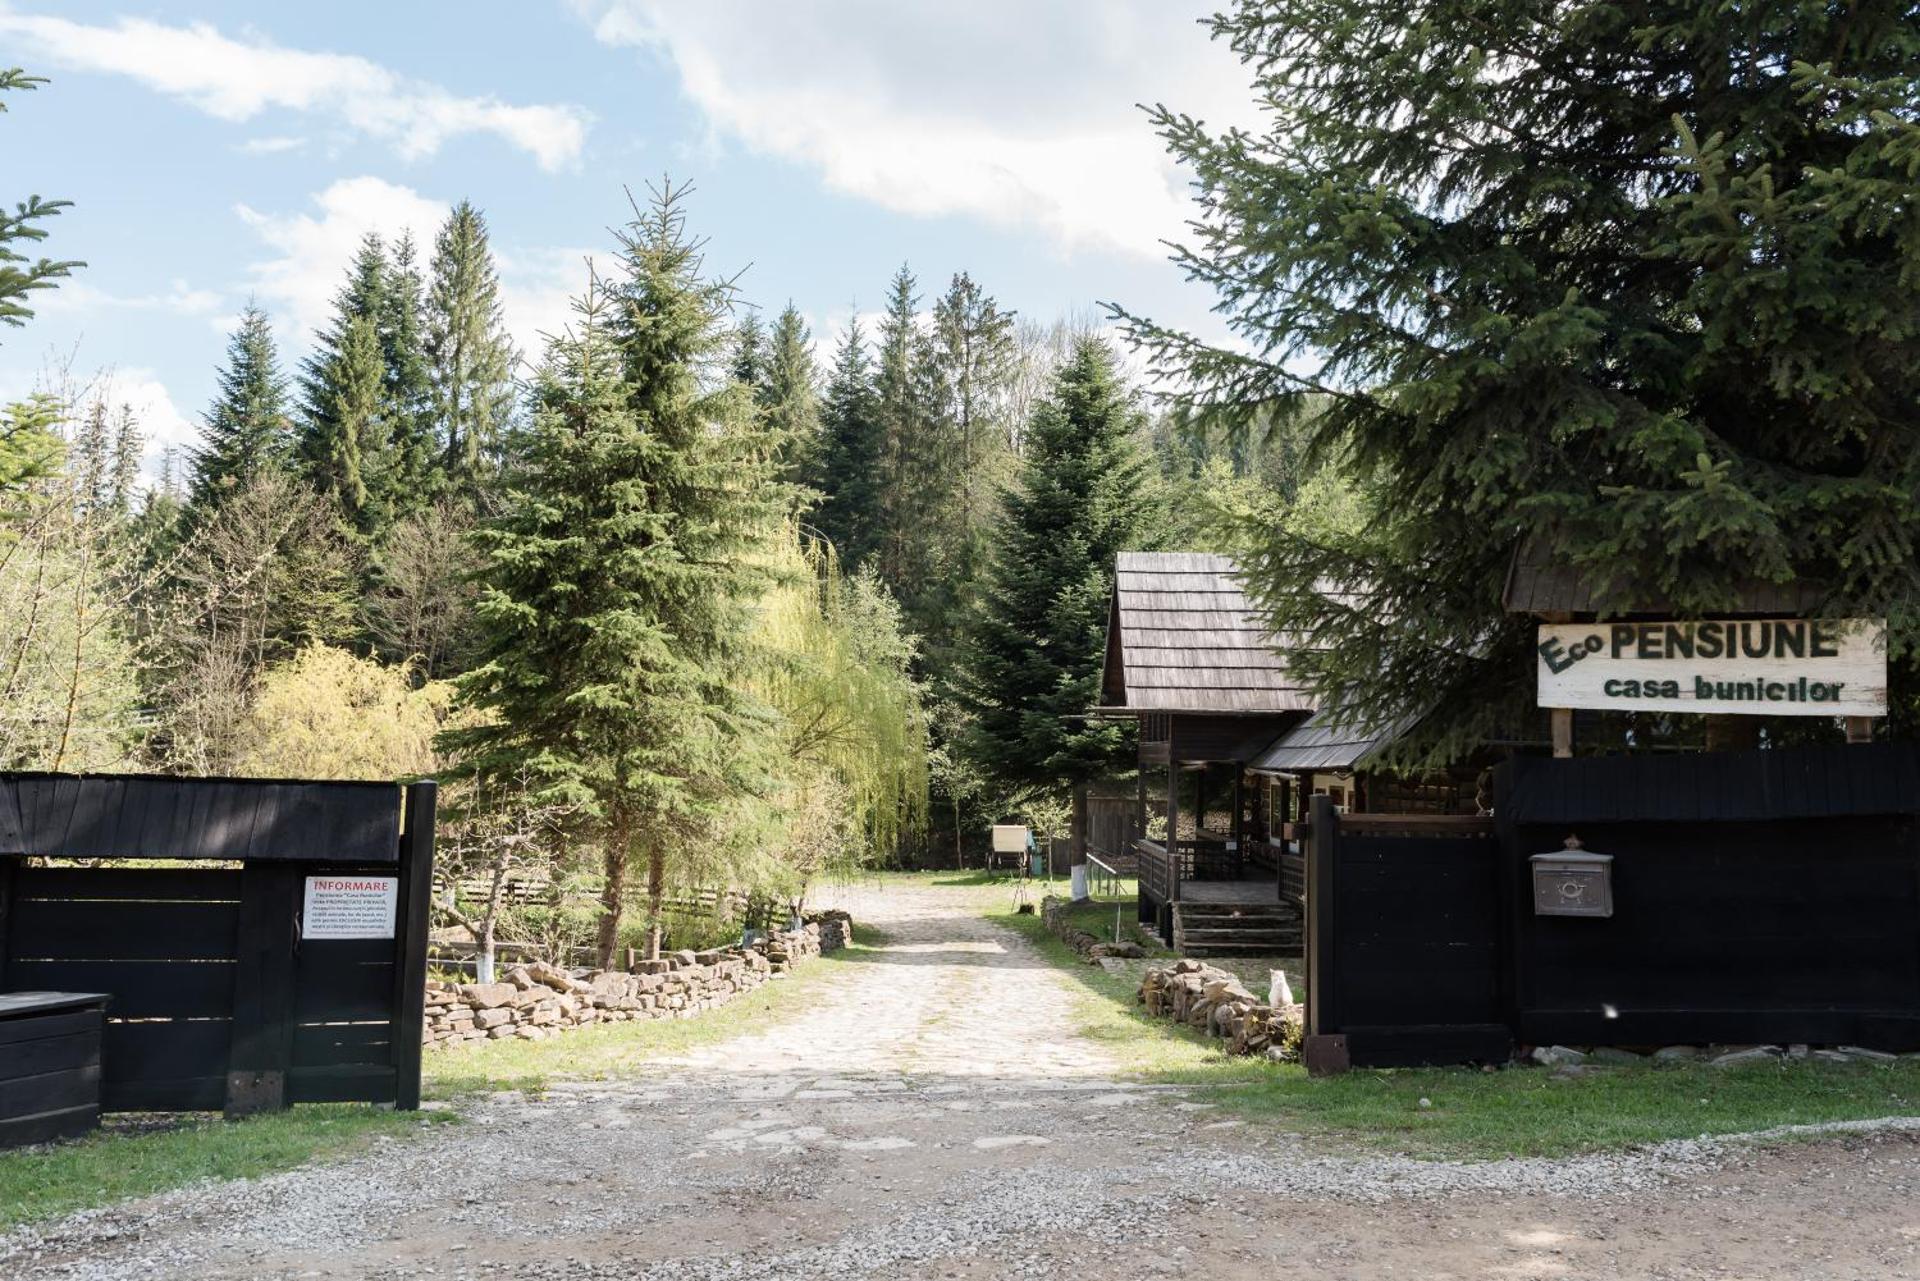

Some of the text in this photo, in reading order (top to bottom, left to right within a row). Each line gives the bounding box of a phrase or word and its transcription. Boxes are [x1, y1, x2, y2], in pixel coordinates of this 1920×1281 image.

[1539, 622, 1838, 675] Eco PENSIUNE
[1604, 675, 1844, 702] casa bunicilor
[313, 881, 389, 891] INFORMARE
